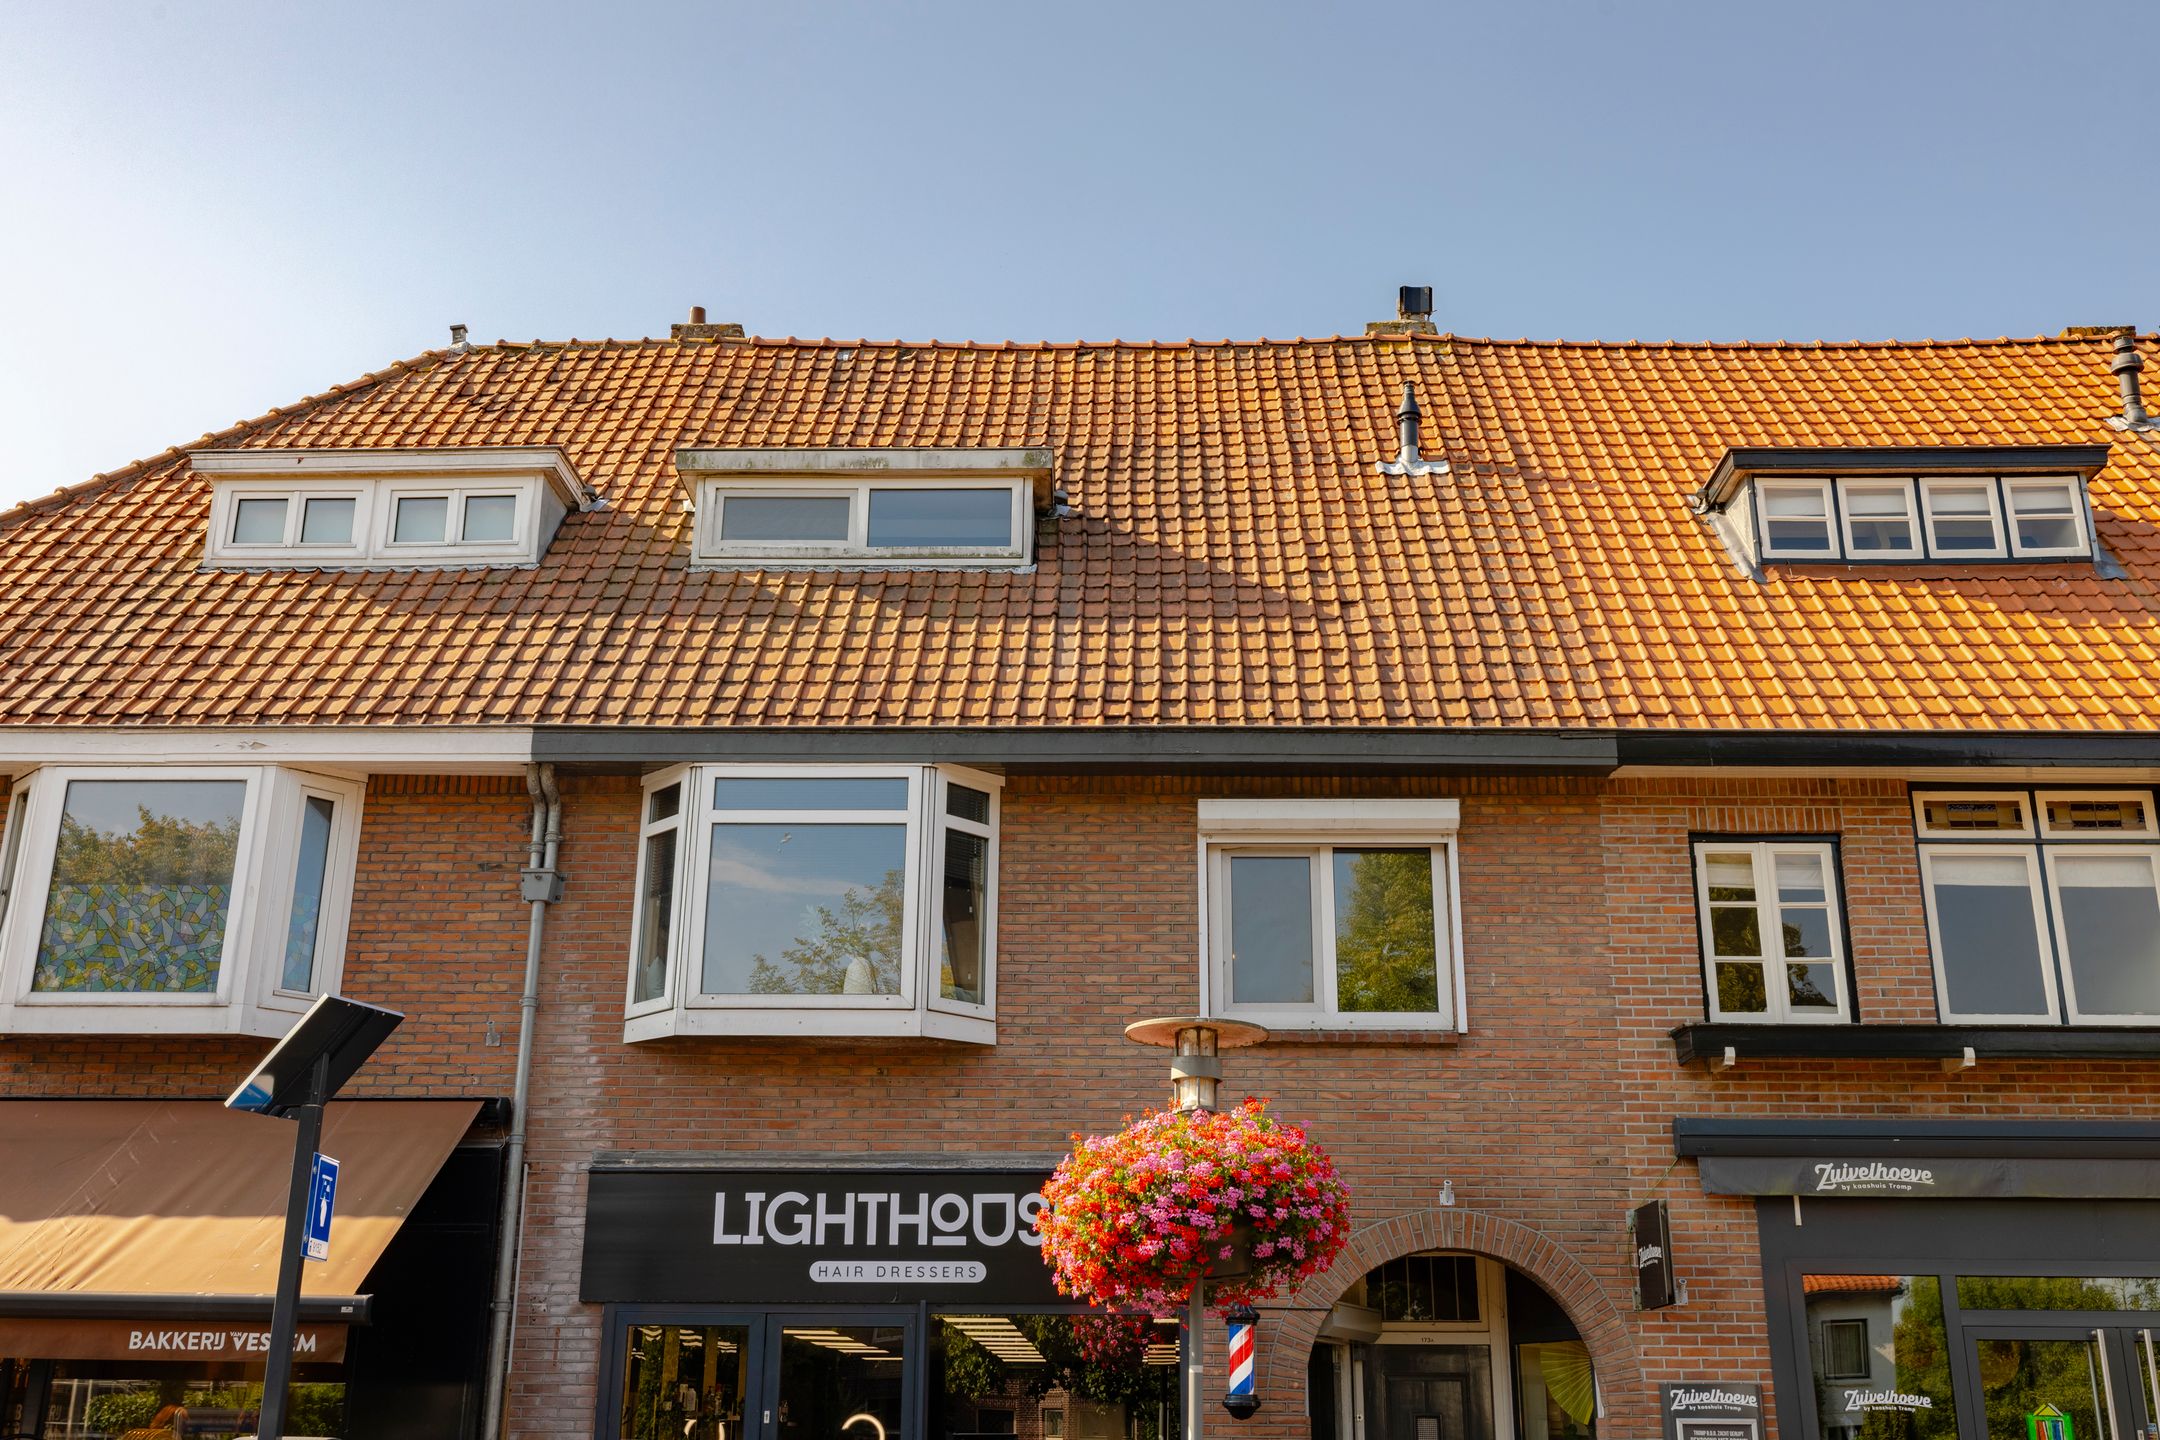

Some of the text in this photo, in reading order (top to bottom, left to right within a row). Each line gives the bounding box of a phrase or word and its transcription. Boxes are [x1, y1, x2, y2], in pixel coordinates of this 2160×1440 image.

[1814, 1162, 1935, 1191] Zuivelhoeve
[1888, 1182, 1912, 1191] Tromp
[713, 1191, 1051, 1246] LIGHTHOUS
[818, 1265, 977, 1278] HAIR DRESSERS
[129, 1331, 226, 1350] BAKKERIJ
[232, 1332, 316, 1352] VESM
[1670, 1388, 1758, 1411] Zuivelhoeve
[1723, 1404, 1742, 1412] Tromp
[1844, 1389, 1933, 1411] Zuivelhoeve
[1898, 1405, 1916, 1413] Tromp
